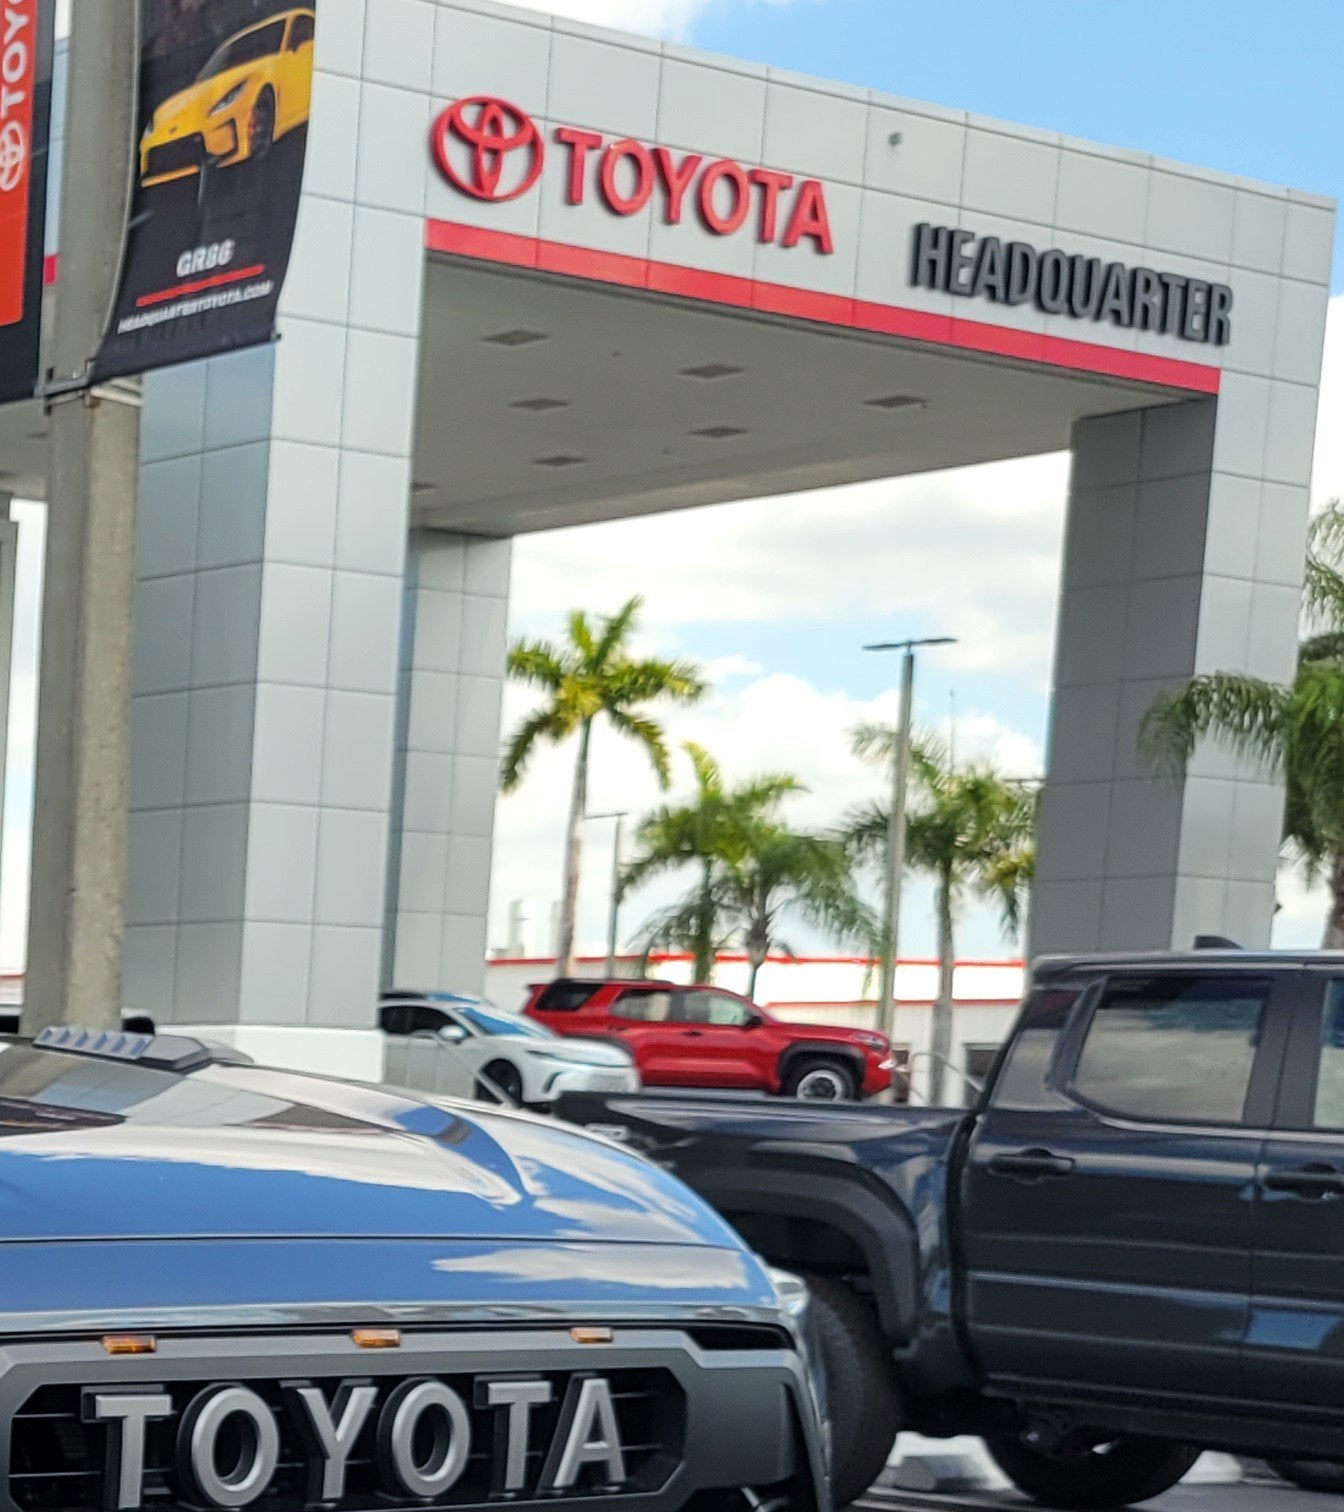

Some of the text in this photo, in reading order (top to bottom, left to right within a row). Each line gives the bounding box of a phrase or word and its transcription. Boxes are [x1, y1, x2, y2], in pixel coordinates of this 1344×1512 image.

[0, 0, 29, 118] TOY
[176, 238, 236, 278] GR86
[555, 127, 1233, 346] TOYOTA HEADQUARTER
[87, 1376, 628, 1511] TOYOTA
